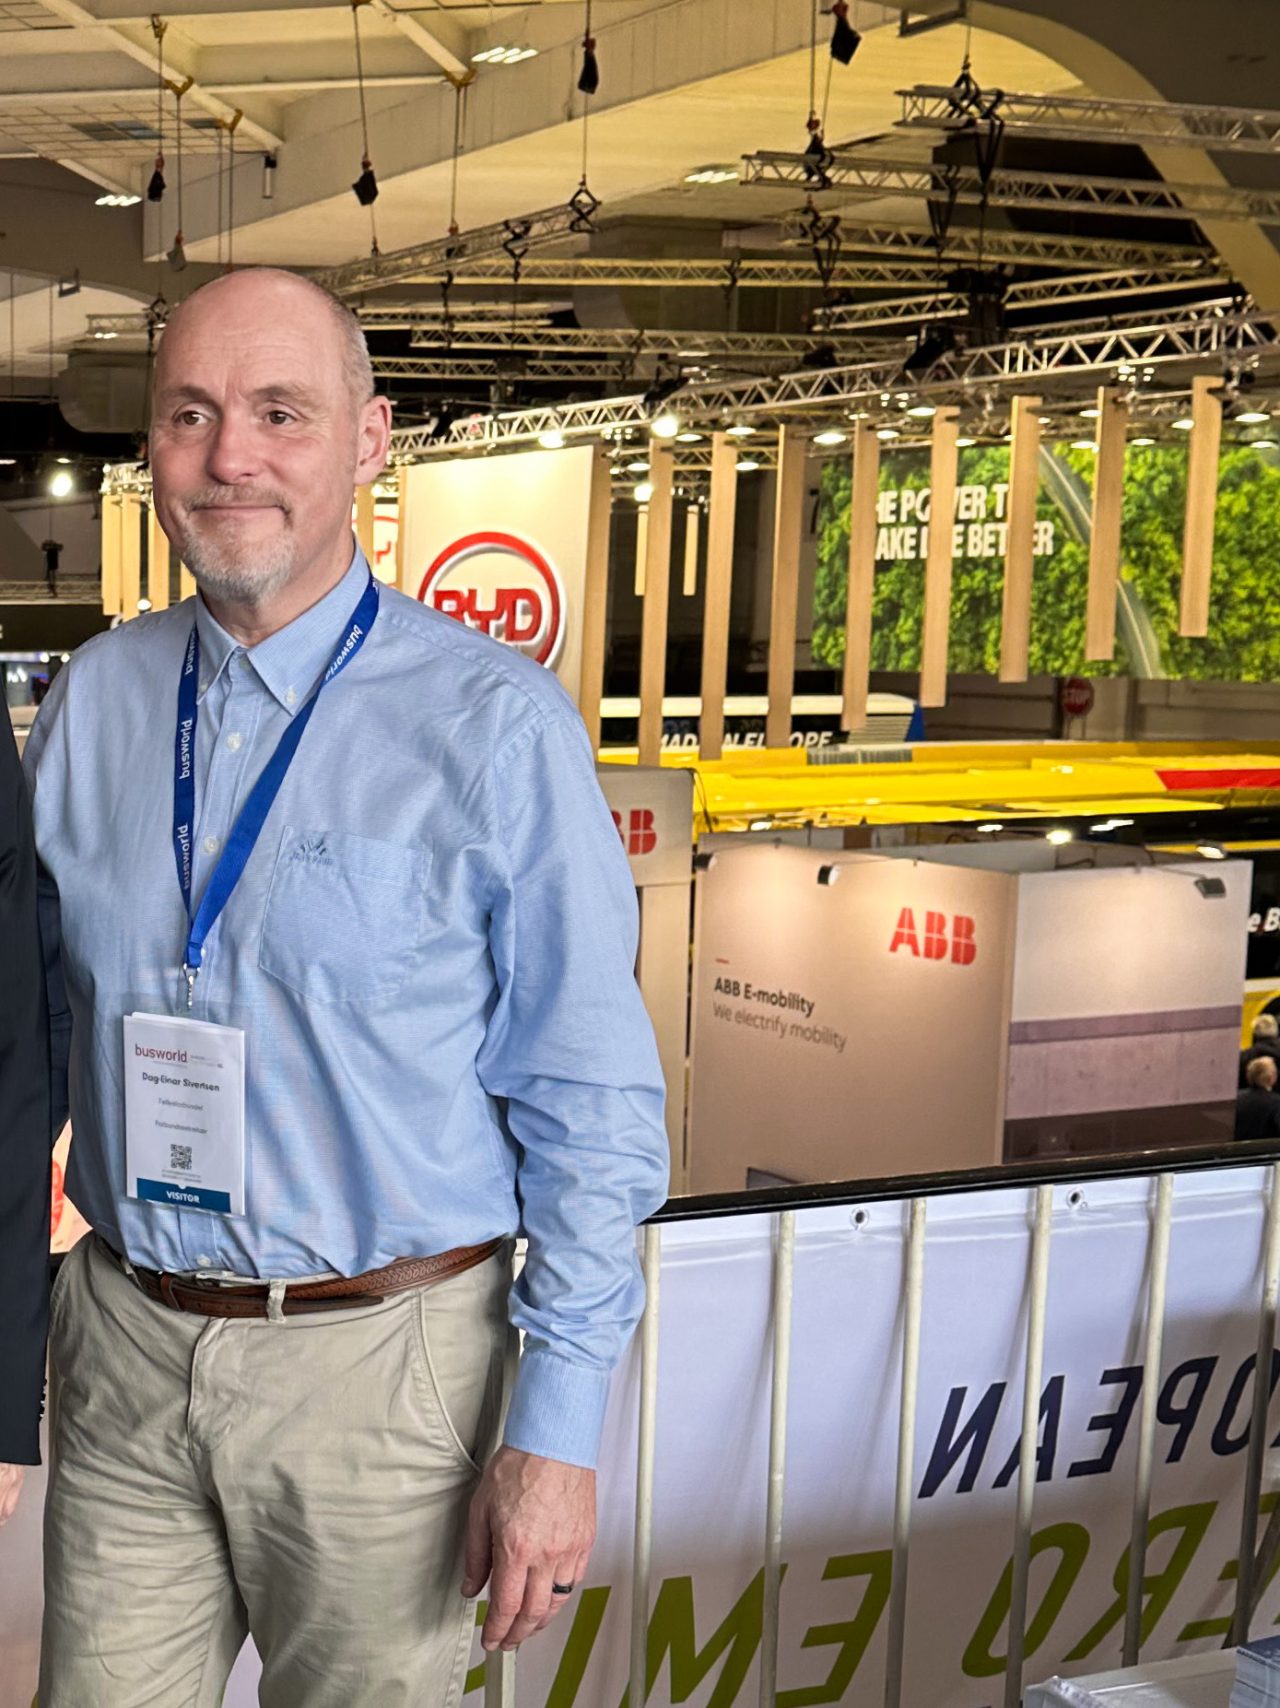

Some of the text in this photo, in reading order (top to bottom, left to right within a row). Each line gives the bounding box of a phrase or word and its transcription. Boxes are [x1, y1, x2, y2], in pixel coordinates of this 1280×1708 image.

[901, 486, 987, 522] POER
[875, 526, 917, 560] AKE
[968, 521, 1054, 557] BETER
[325, 624, 362, 681] busworld
[179, 718, 193, 779] busworld
[889, 907, 977, 966] ABB
[714, 977, 815, 1018] ABB E-mobility
[713, 1002, 847, 1053] We electrify mobility
[135, 1043, 188, 1063] busworld
[166, 1191, 200, 1204] VISITOR
